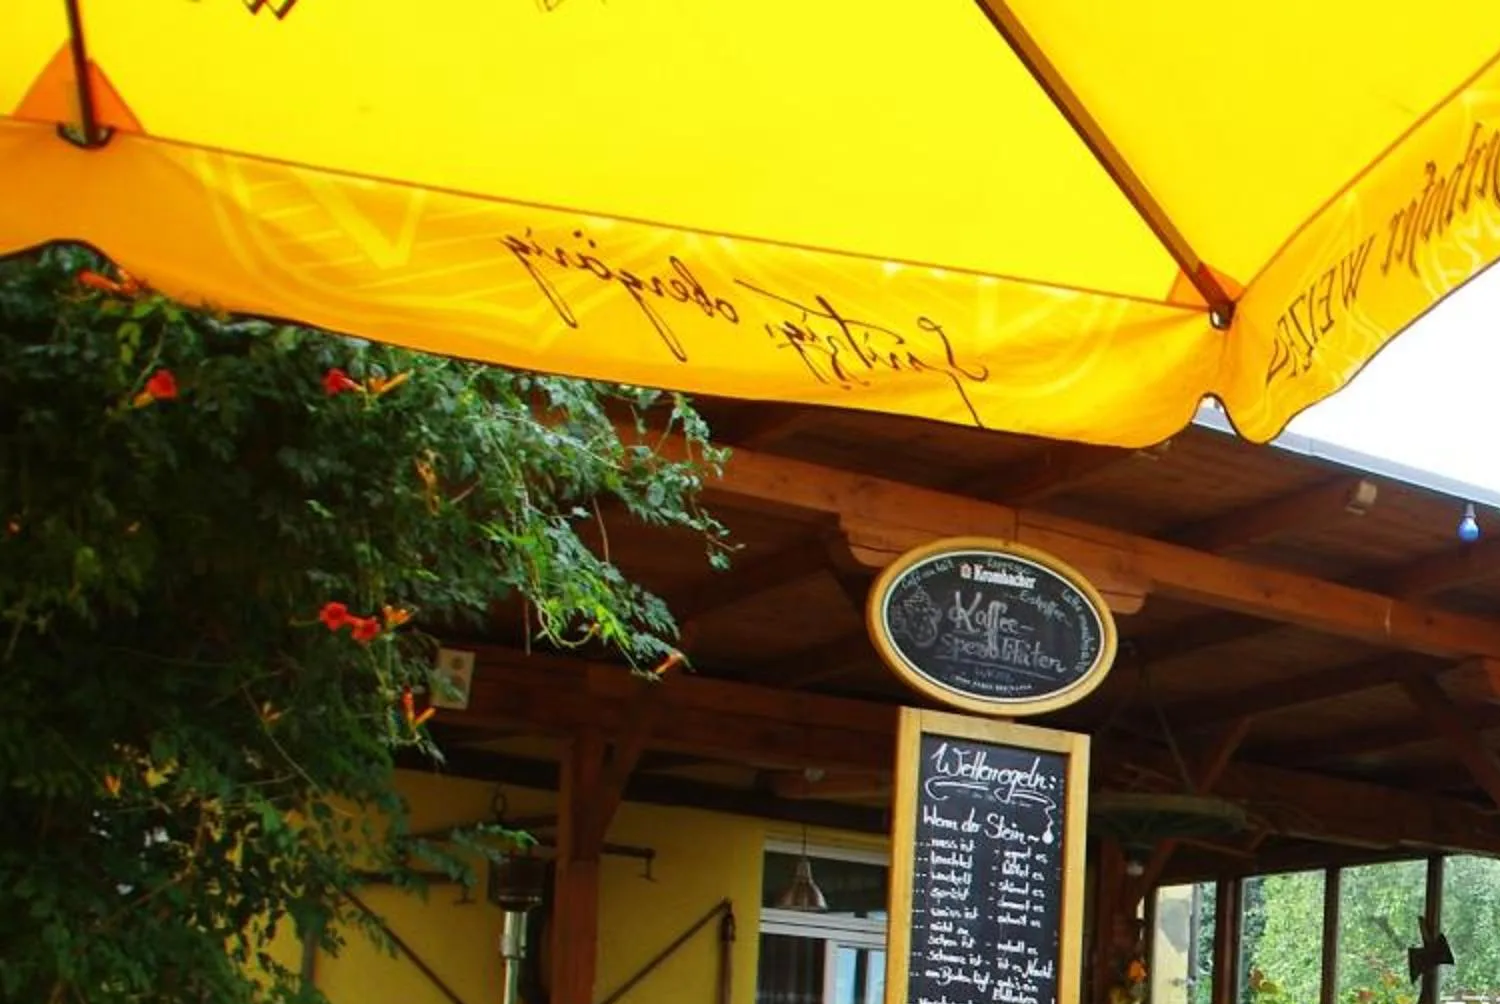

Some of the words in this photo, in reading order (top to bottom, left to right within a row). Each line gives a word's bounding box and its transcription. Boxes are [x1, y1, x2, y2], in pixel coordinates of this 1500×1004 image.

[974, 563, 1036, 589] Krombacher
[923, 804, 958, 831] Wenn
[961, 806, 981, 833] der
[984, 812, 1027, 845] Stein
